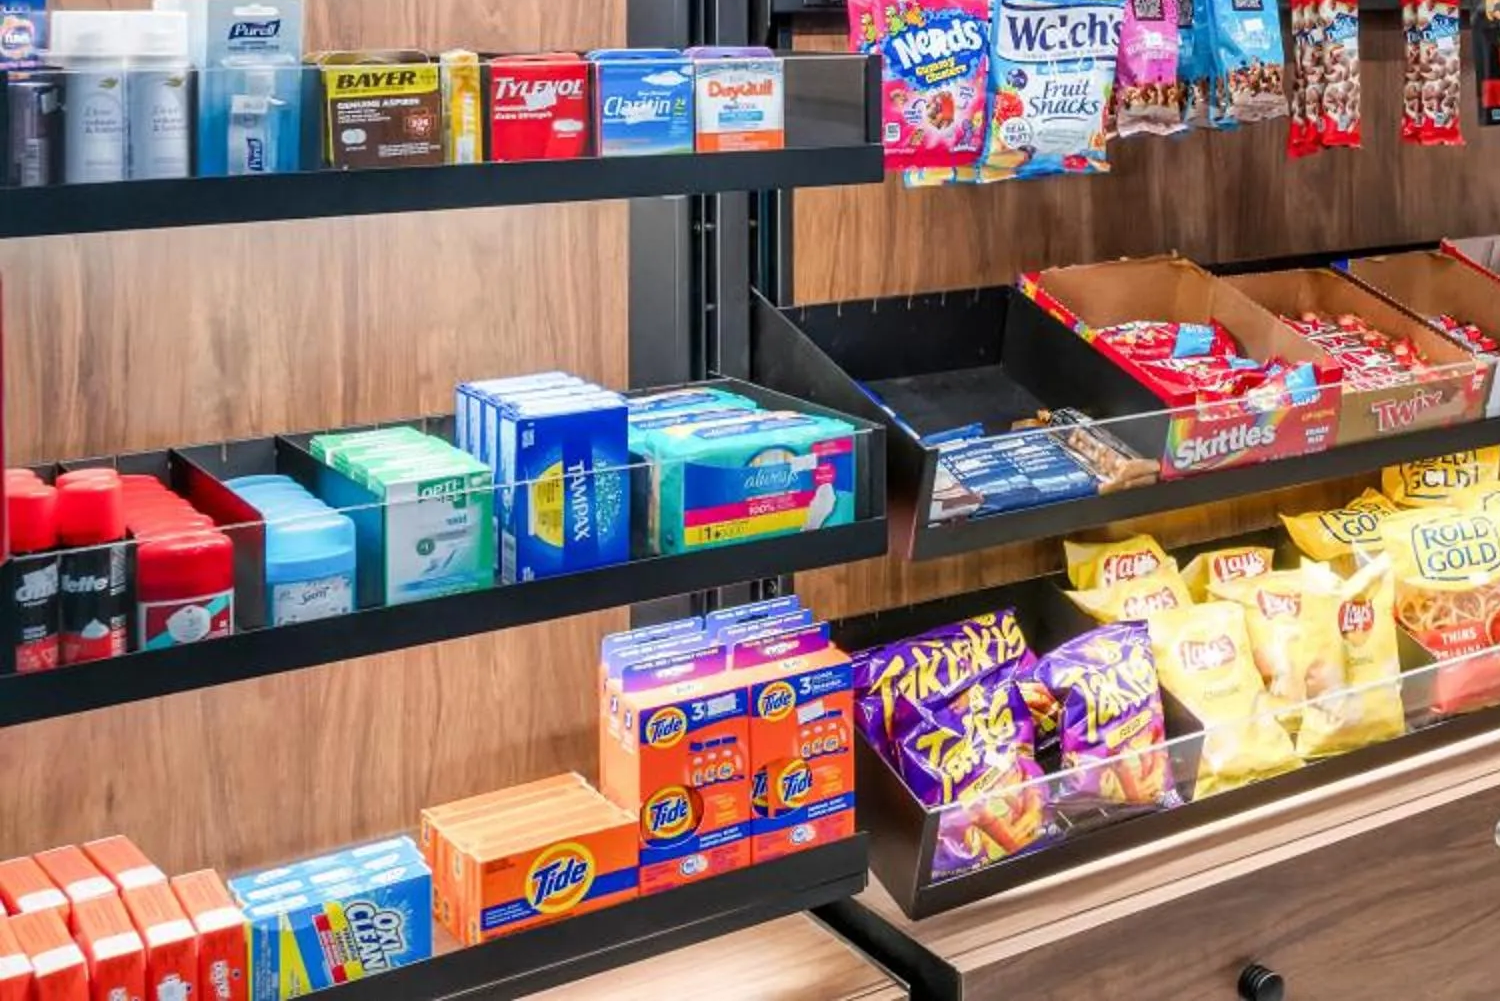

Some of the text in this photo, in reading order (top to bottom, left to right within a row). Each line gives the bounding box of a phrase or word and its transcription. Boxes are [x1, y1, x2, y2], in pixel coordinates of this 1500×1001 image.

[891, 18, 983, 70] Nerds
[336, 70, 416, 89] BAYER
[493, 77, 584, 100] TYLENOL
[1043, 79, 1090, 99] Fruit
[603, 96, 671, 117] Claritin
[1027, 96, 1099, 118] Snacks
[1173, 423, 1277, 469] Skittles
[568, 459, 590, 542] TAMPAX
[1421, 519, 1490, 550] ROLD
[1428, 542, 1497, 572] GOLD
[762, 677, 812, 716] Tide 3
[648, 703, 706, 744] Tide 3
[531, 858, 589, 909] Tide
